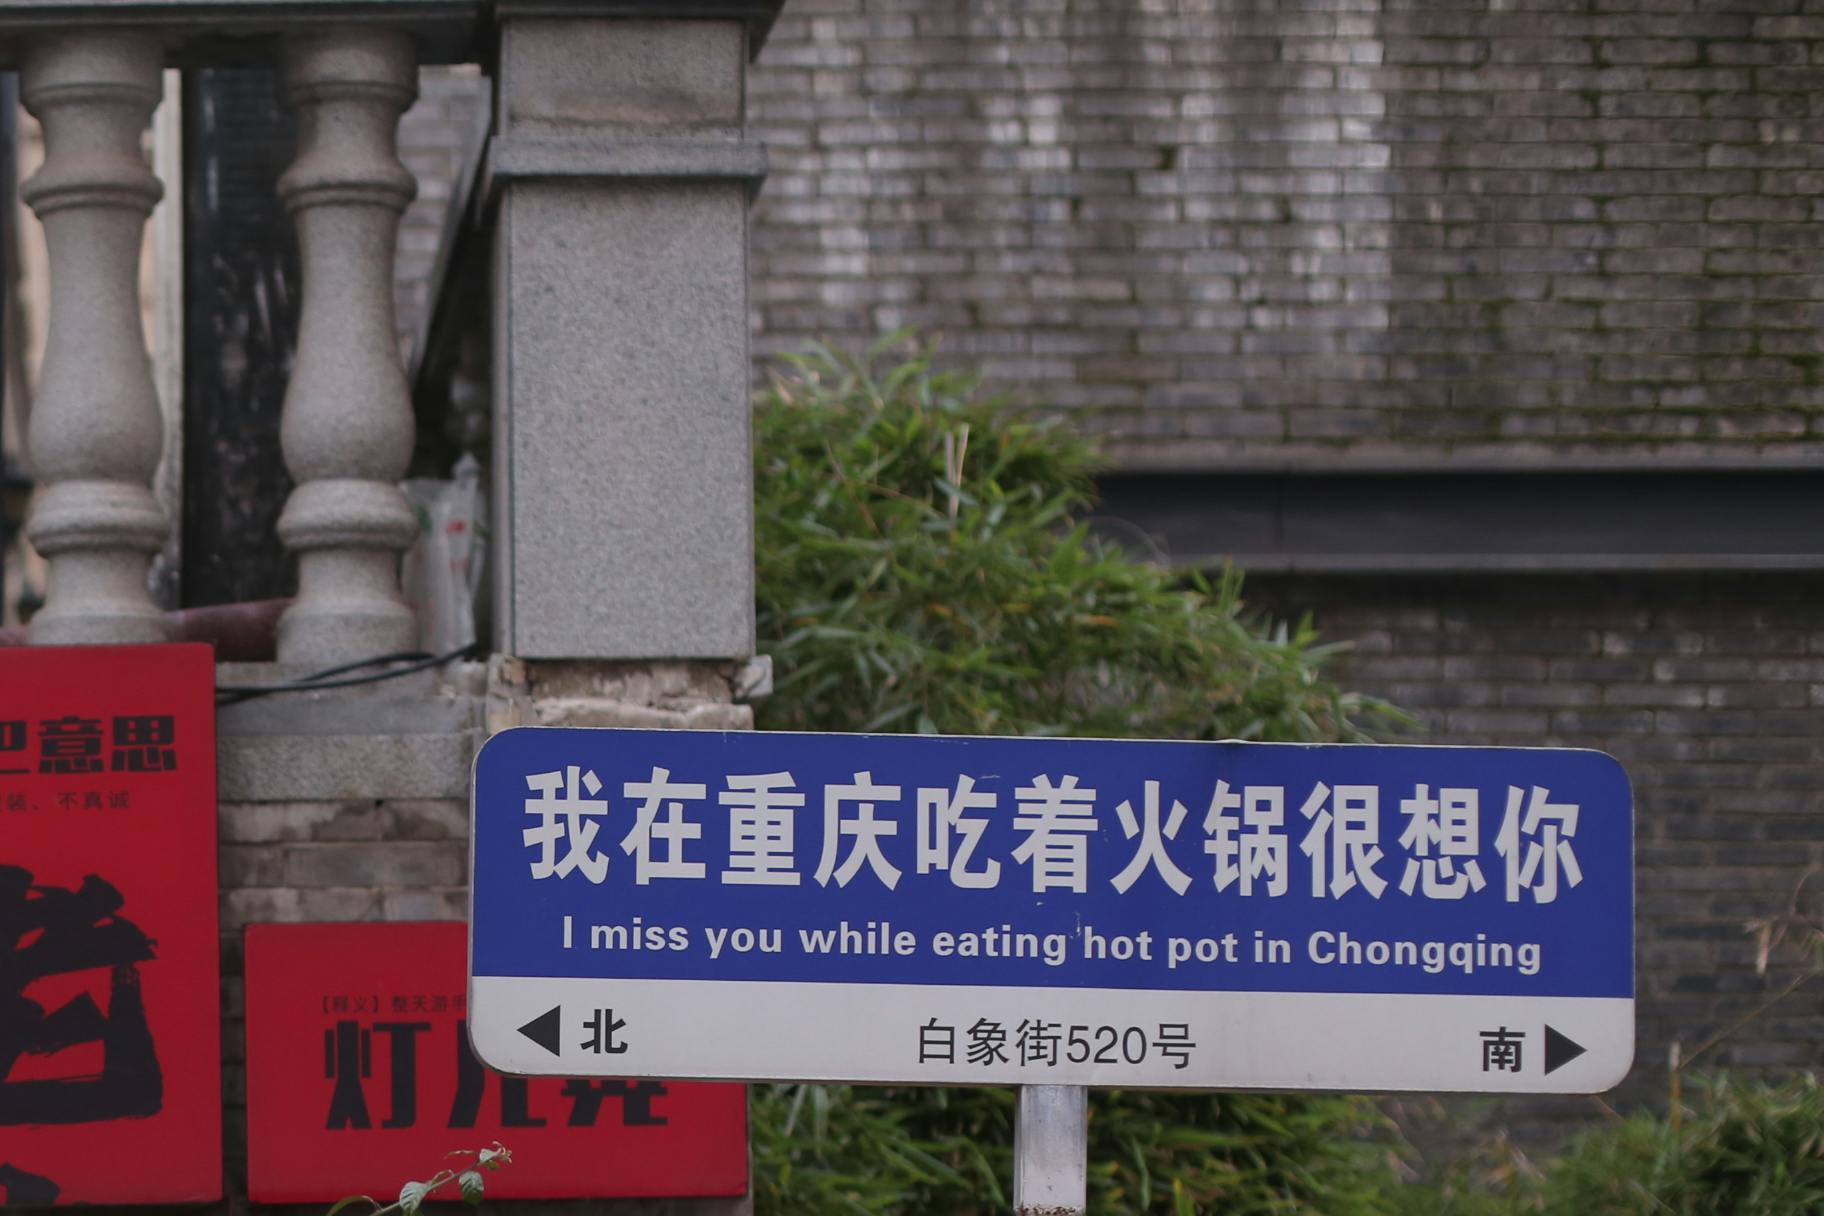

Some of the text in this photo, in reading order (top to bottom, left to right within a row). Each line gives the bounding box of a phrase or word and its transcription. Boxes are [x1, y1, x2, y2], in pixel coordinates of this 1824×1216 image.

[522, 765, 1583, 904] 我在重庆吃着火锅很想你
[562, 915, 1542, 976] I miss you while eating hot pot in Chongqing
[580, 1008, 1527, 1074] 北 白象街520号 南
